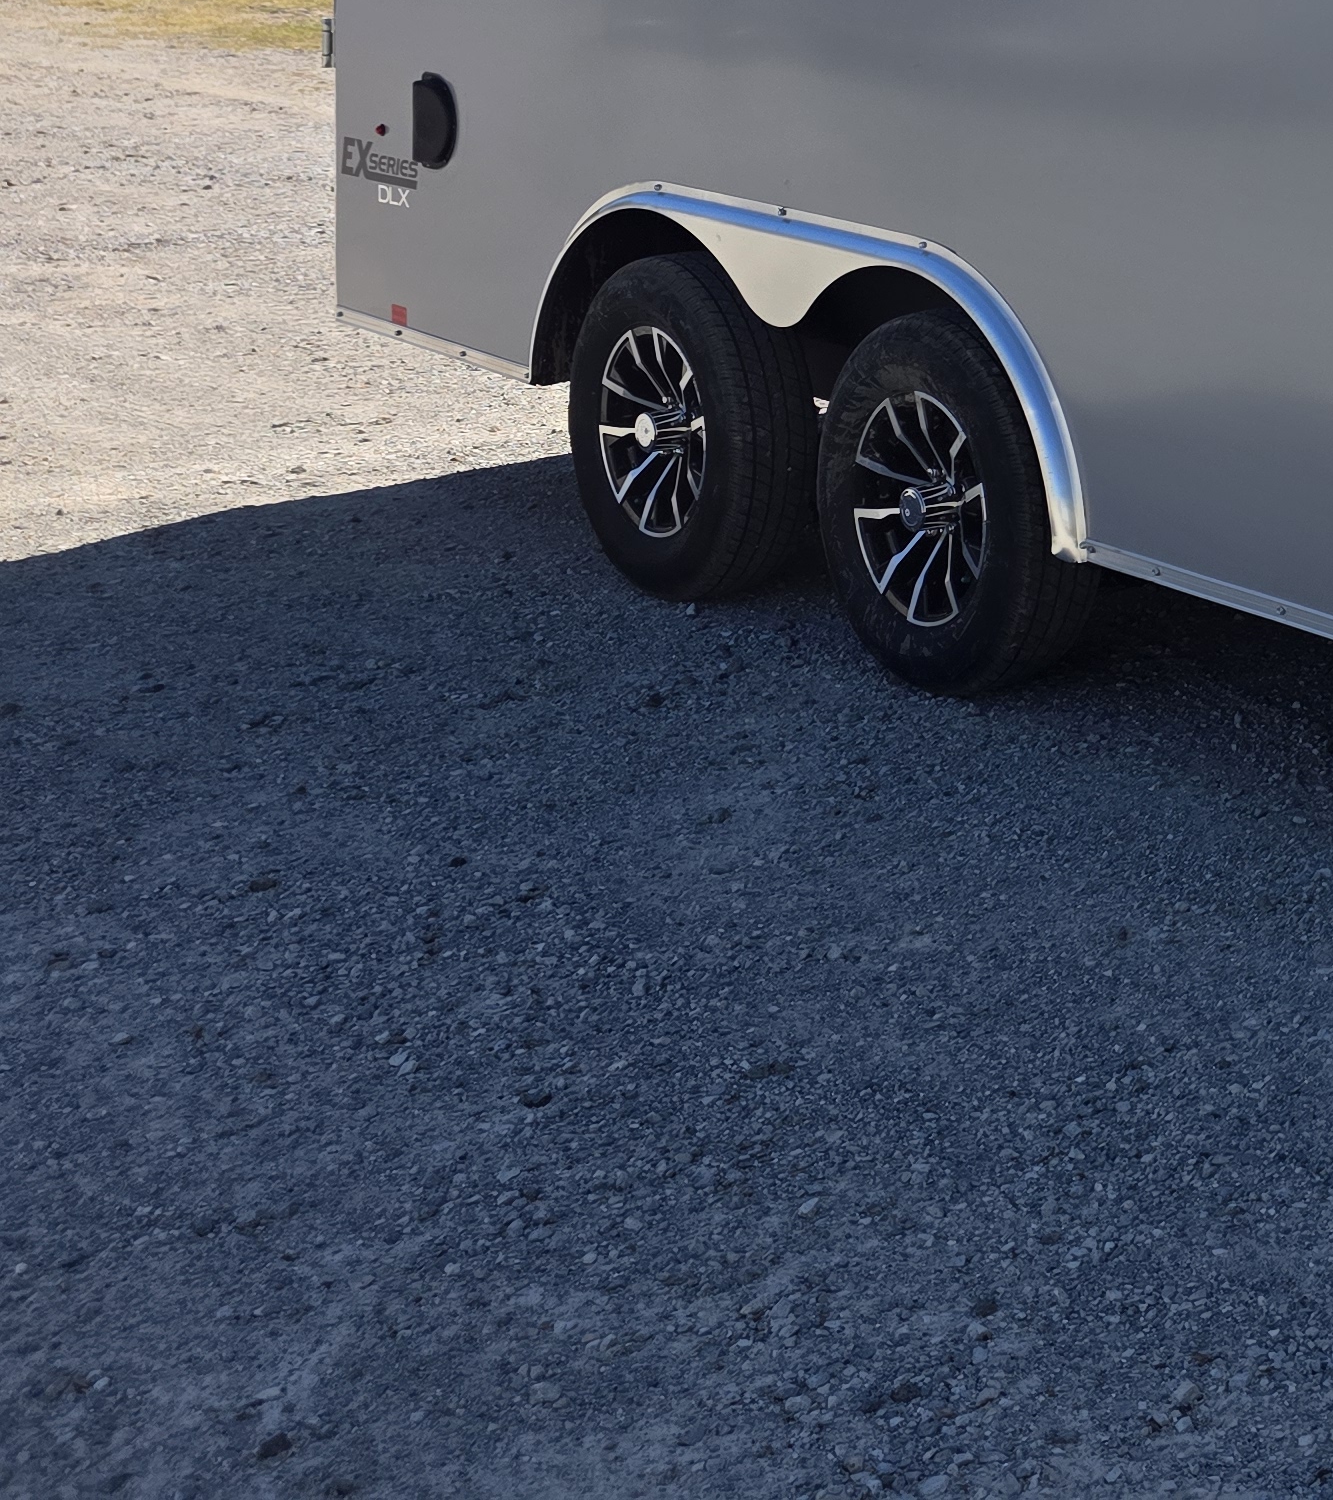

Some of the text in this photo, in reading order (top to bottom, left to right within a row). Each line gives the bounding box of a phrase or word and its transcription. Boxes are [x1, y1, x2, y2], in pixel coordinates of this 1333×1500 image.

[341, 136, 418, 178] EX SERIES
[378, 184, 410, 208] DLX
